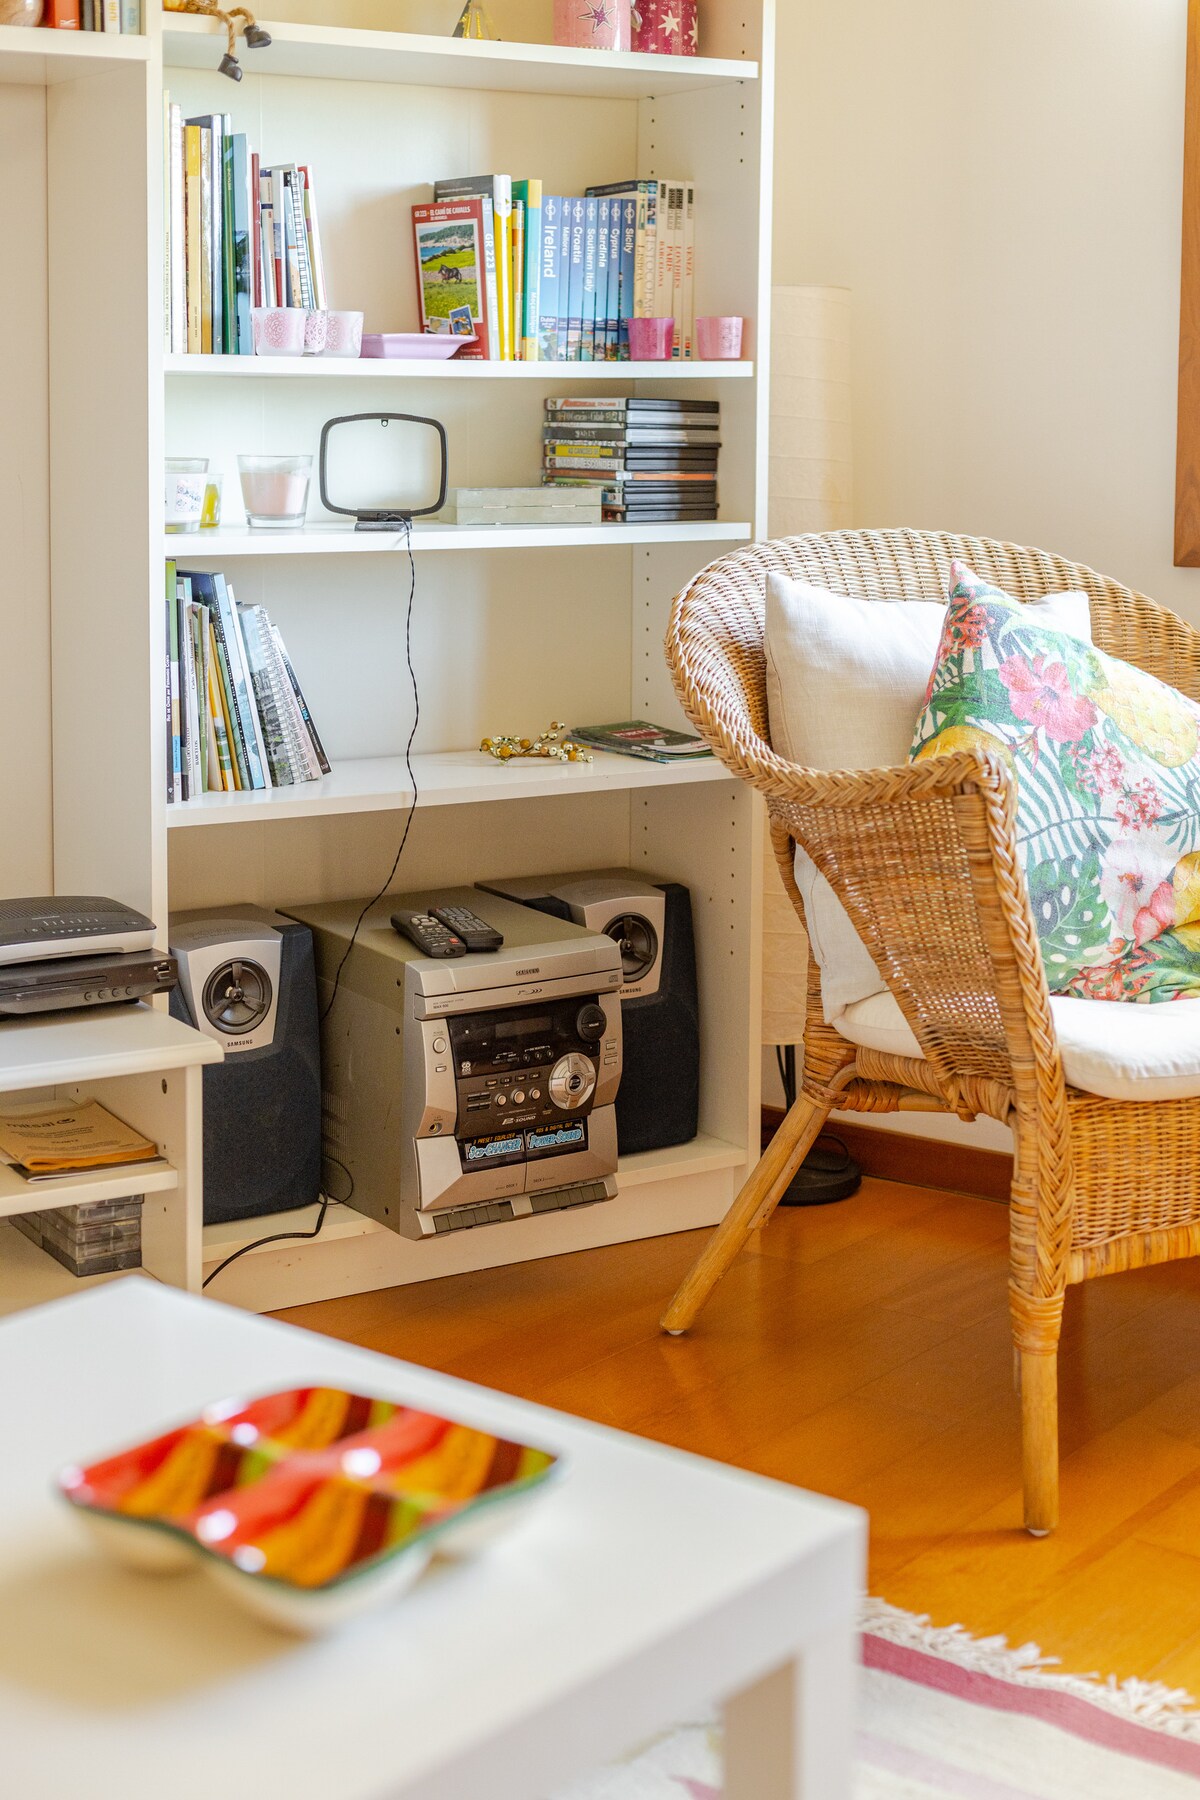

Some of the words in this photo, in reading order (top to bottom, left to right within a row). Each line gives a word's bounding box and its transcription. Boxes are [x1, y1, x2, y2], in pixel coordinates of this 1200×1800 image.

[485, 233, 494, 248] GR
[543, 225, 557, 278] Ireland
[562, 226, 570, 257] Mallorca
[573, 226, 583, 264] Croatia
[586, 228, 596, 270] Southern
[599, 227, 608, 268] Sardinia
[610, 228, 620, 259] Cyprus
[623, 227, 635, 254] Sicily
[485, 250, 496, 269] 223
[666, 245, 674, 273] PARIS
[674, 245, 682, 289] LONDRES
[685, 245, 693, 277] VENEZA
[584, 272, 595, 293] Italy
[529, 291, 538, 334] Moçambique
[296, 694, 310, 721] PORTUGAL
[619, 987, 642, 995] SAMSUNG
[227, 1039, 254, 1048] SAMSUNG
